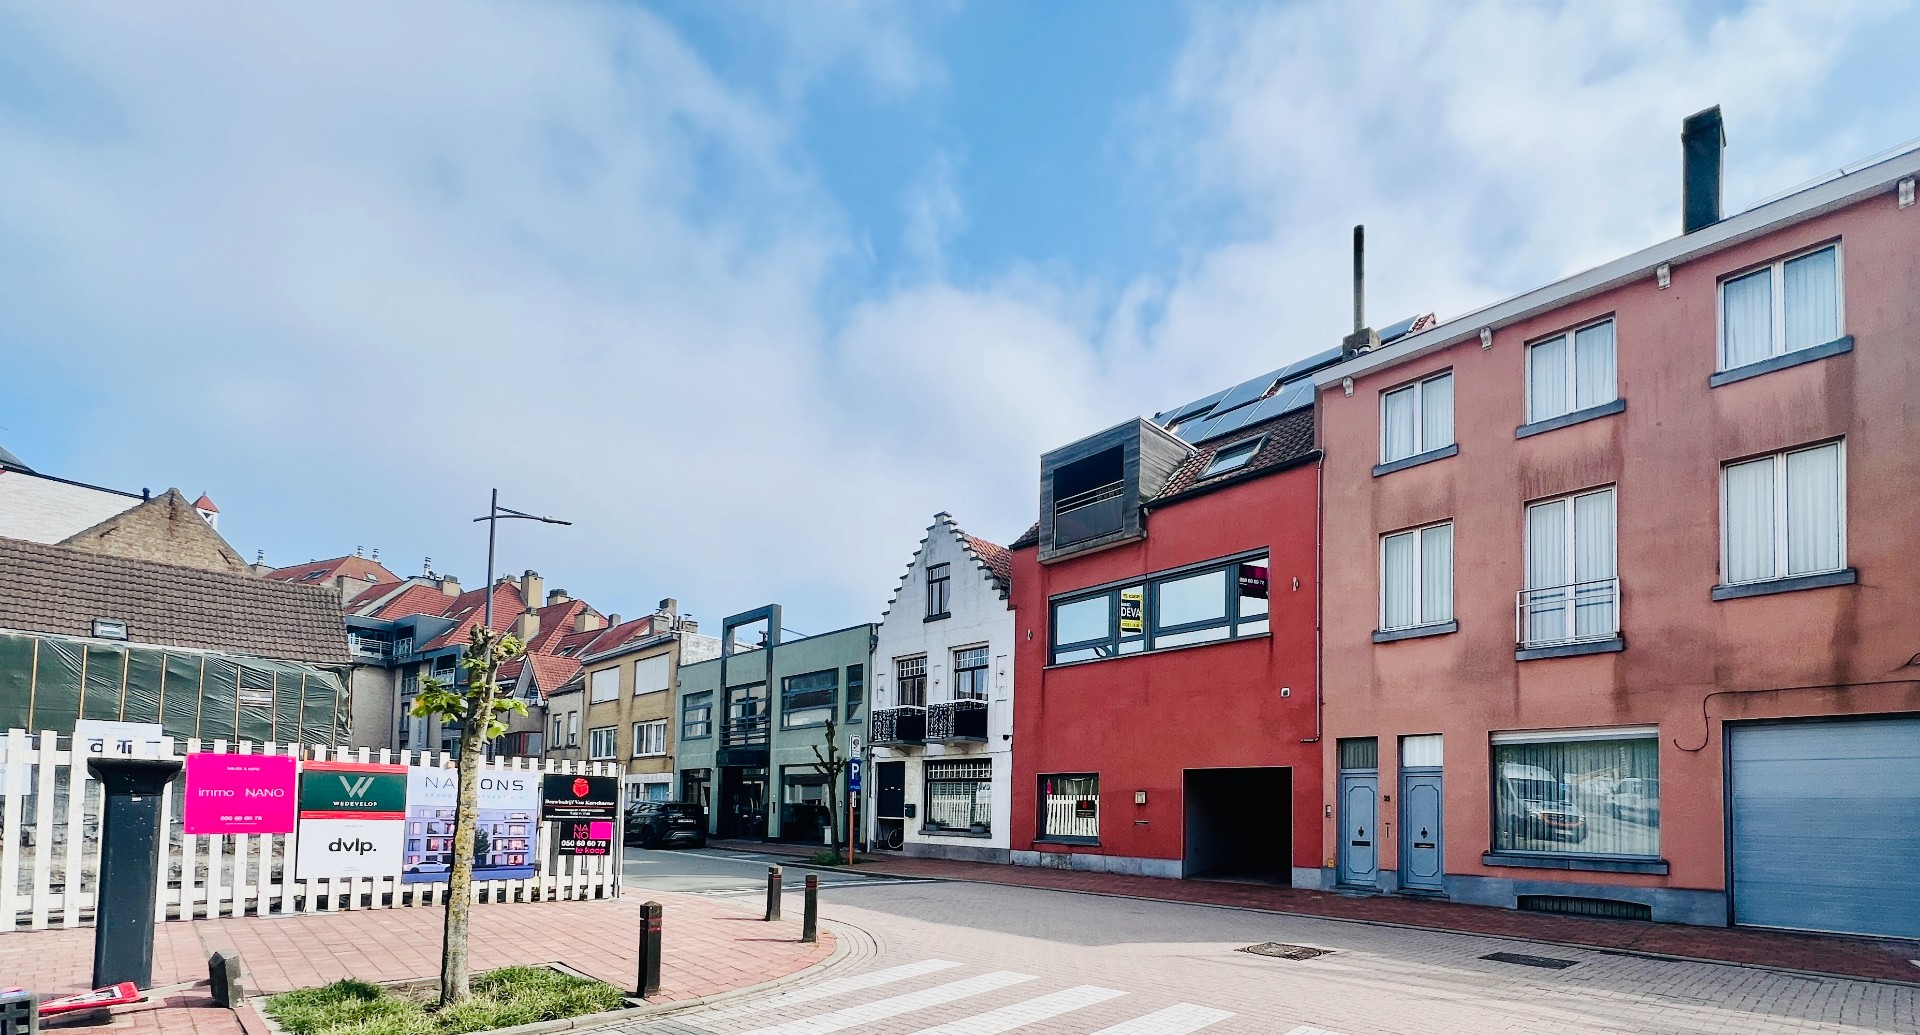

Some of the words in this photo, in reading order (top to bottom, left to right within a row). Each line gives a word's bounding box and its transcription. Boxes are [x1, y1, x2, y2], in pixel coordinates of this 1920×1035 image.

[1121, 606, 1141, 618] DEVA
[851, 762, 860, 780] P
[425, 776, 524, 791] NAONS
[198, 787, 235, 797] immo
[245, 788, 285, 798] NANO
[328, 838, 377, 855] dvlp.
